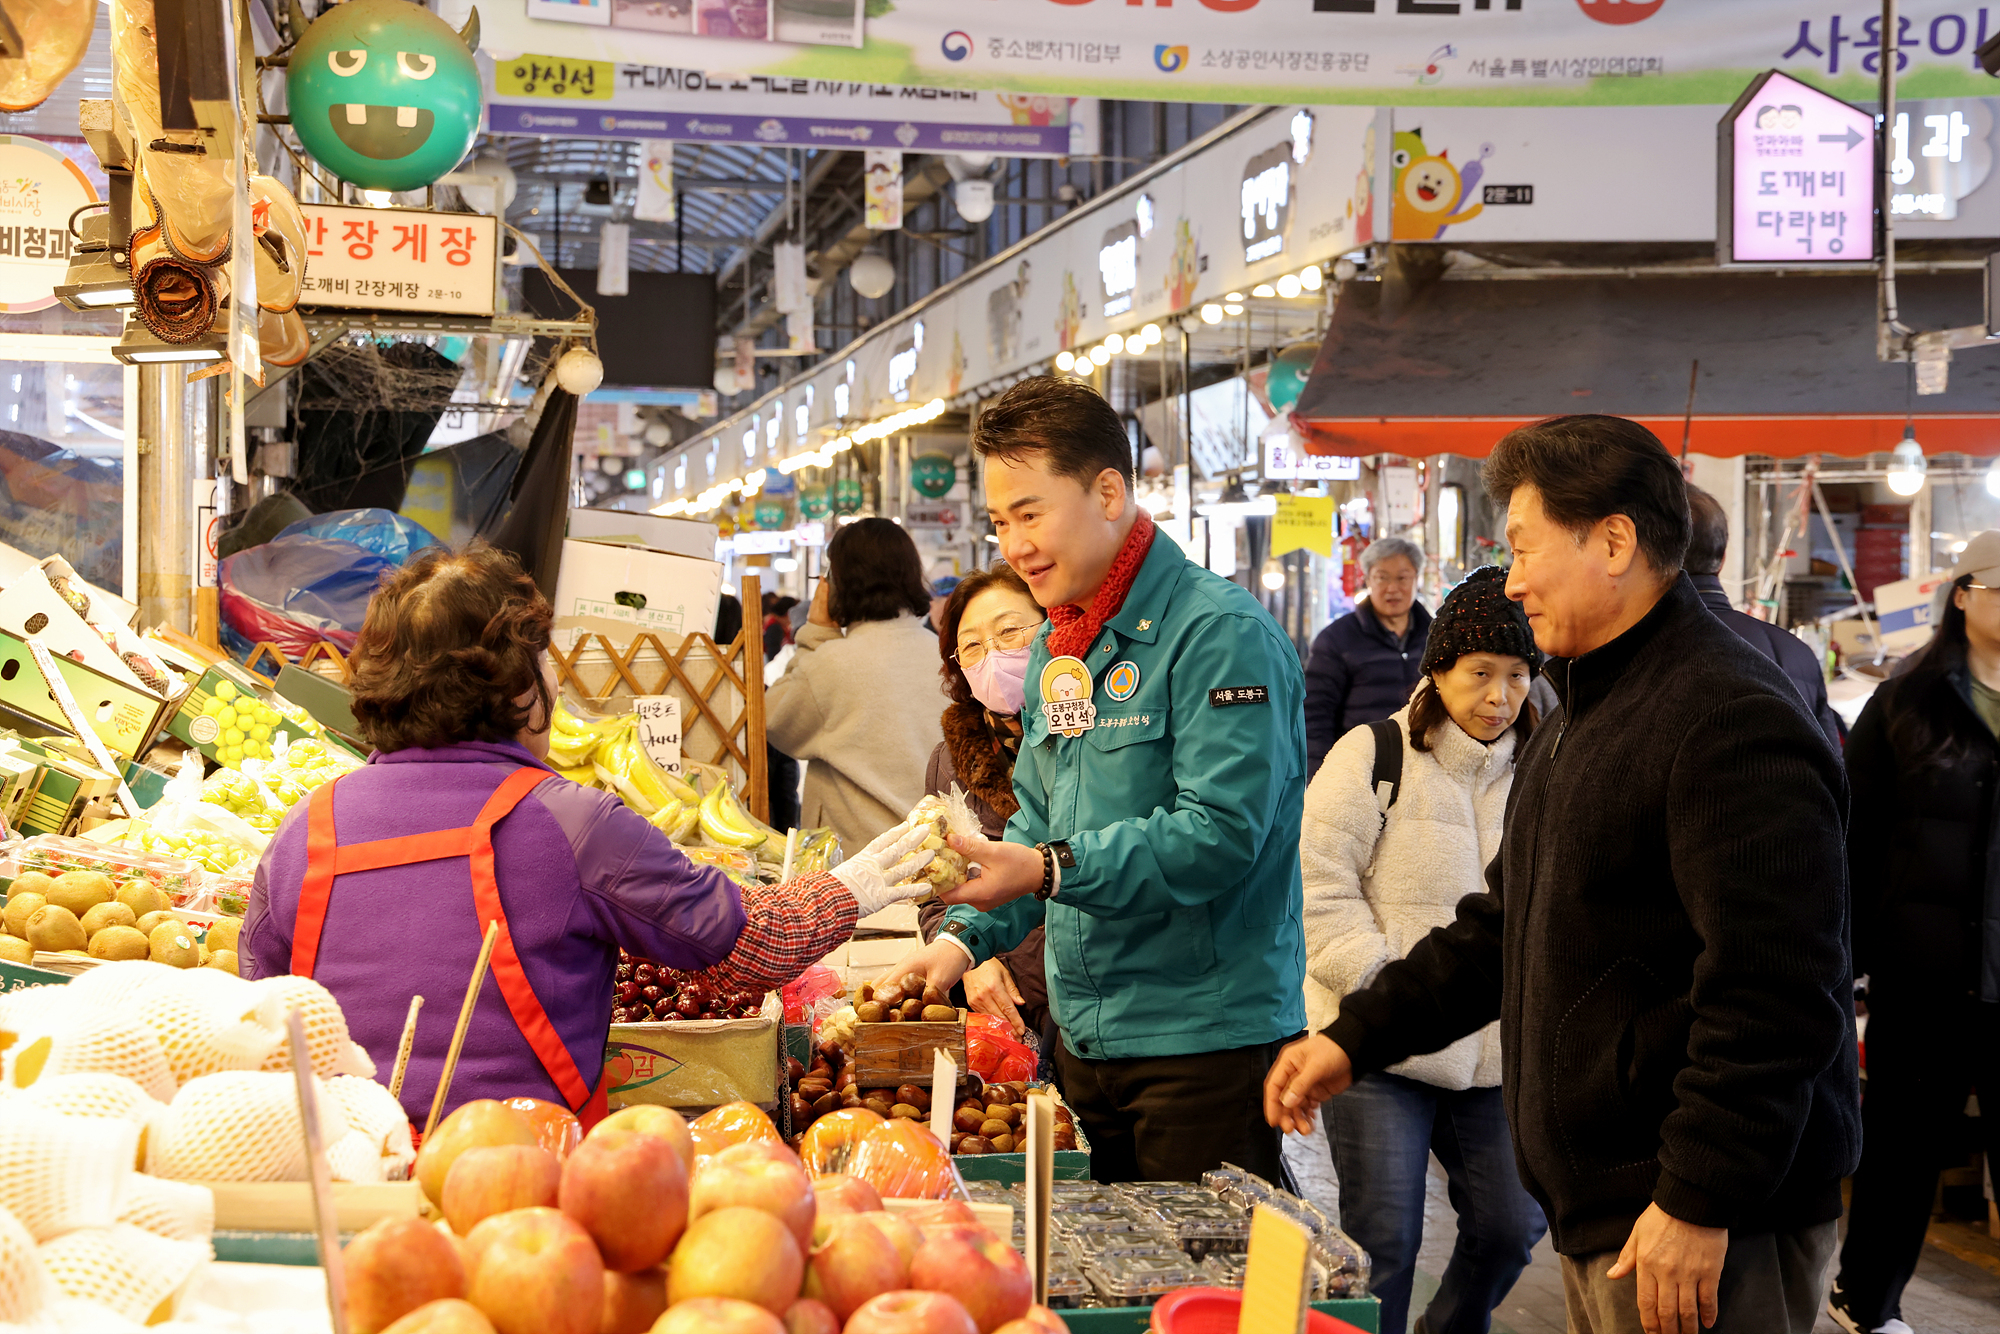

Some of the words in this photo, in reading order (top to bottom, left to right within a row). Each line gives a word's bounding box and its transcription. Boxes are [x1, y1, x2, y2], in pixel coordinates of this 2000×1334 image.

[987, 36, 1122, 64] 중소벤처기업부
[1200, 48, 1370, 72] 소상공인시장진흥공단
[1468, 56, 1664, 79] 서울특별시상인연합회
[1757, 170, 1845, 197] 도깨비
[0, 196, 42, 217] 비시장
[1485, 187, 1532, 204] 2문-11
[1757, 211, 1847, 254] 다락방
[303, 276, 349, 294] 도깨비
[354, 279, 420, 299] 간장게장
[427, 289, 463, 299] 2문-10
[1051, 700, 1085, 713] 도봉구청장
[1215, 689, 1235, 702] 서울
[1237, 688, 1265, 700] 도봉구
[1051, 710, 1090, 727] 오언석
[633, 1055, 657, 1078] 감
